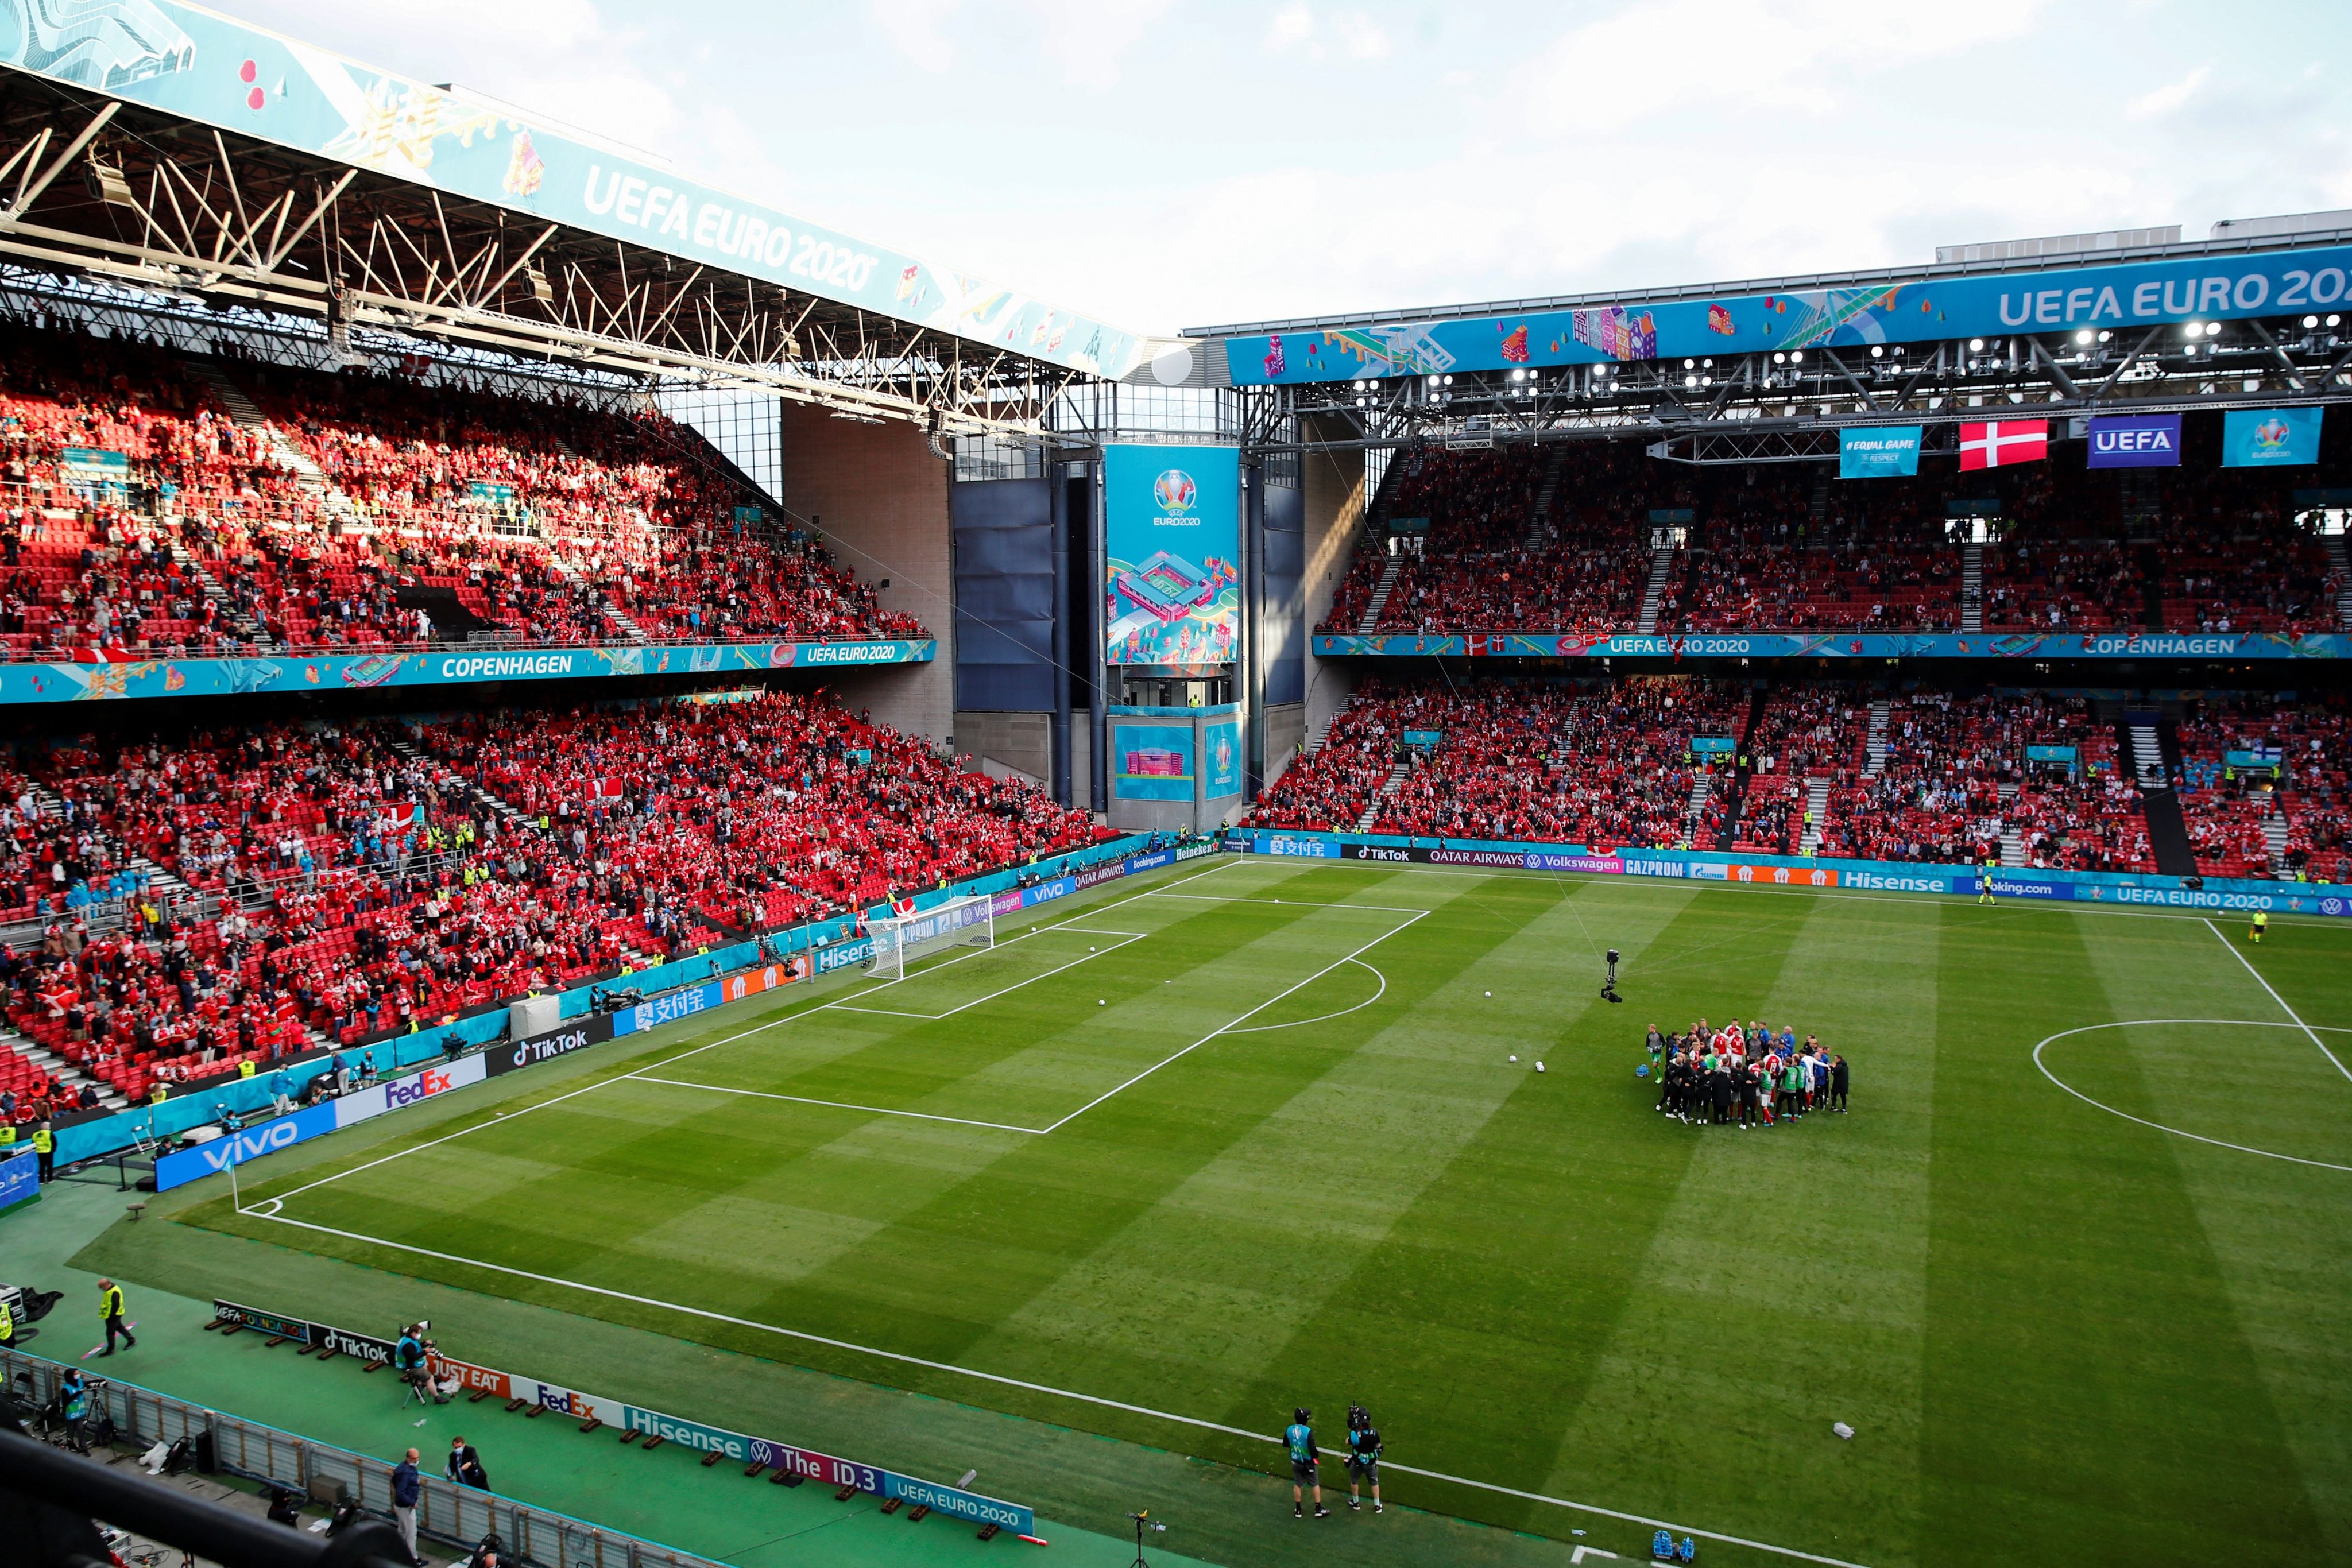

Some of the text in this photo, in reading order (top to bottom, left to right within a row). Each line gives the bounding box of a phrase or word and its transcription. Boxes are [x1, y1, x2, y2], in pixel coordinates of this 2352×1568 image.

[583, 165, 876, 292] UEFA EURO 2020
[1999, 268, 2352, 326] UEFA EURO 20
[1846, 439, 1914, 451] #EQUAL GAME
[2096, 431, 2171, 451] UEFA
[1870, 454, 1899, 462] RESPECT
[808, 645, 895, 662] UEFA EURO 2020
[1611, 639, 1654, 652] UEFA
[1706, 639, 1749, 652] 2020
[2084, 639, 2234, 653] COPENHAGEN
[442, 655, 572, 677] COPENHAGEN
[1176, 843, 1212, 861] Heineken
[1285, 841, 1325, 857] 支付宝
[1371, 848, 1409, 862] TikTok
[1430, 850, 1524, 866] QATAR AIRWAYS
[1133, 854, 1166, 869] Booking.com
[1545, 855, 1619, 873] Volkswagen
[1626, 860, 1683, 877] GAZPROM
[1074, 863, 1125, 888] QATAR AIRWAYS
[1845, 872, 1944, 892] Hisense
[1034, 883, 1063, 901] vivo
[1975, 880, 2052, 895] Boking.com
[974, 895, 1019, 917] Volswagen
[2117, 888, 2272, 909] UEFA EURO 2020
[819, 937, 888, 971] Hisense
[655, 988, 705, 1024] 支付宝
[532, 1029, 587, 1060] TikTok
[385, 1069, 452, 1109] FedEx
[202, 1121, 298, 1170] vivo
[215, 1304, 307, 1338] UEFA FOUNDATION
[339, 1337, 389, 1364] TikTok
[433, 1359, 500, 1392] JUST EAT
[538, 1384, 595, 1419] FedEx
[632, 1409, 742, 1459] Hisense
[782, 1447, 821, 1478] The
[833, 1461, 876, 1492] ID.3
[897, 1481, 1020, 1527] UEFA EURO 2020
